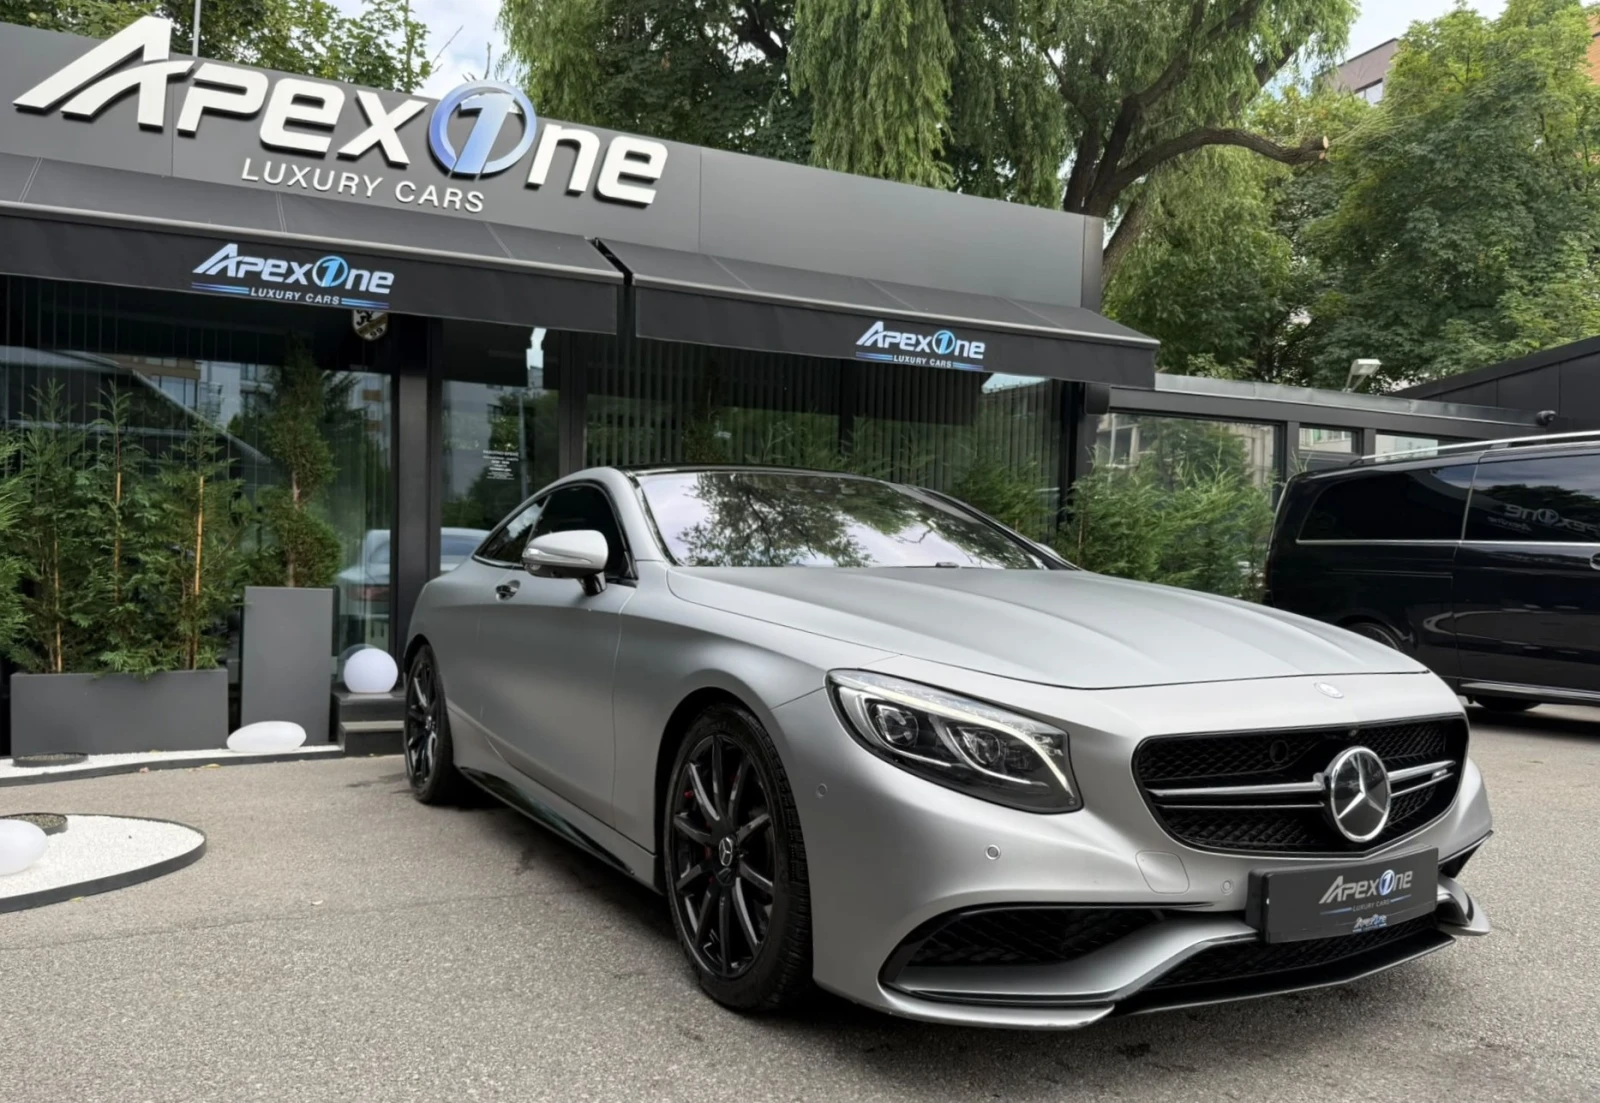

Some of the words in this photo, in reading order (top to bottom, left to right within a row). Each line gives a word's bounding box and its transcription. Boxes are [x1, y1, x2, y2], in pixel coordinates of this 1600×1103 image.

[241, 157, 383, 198] LUXURY
[394, 180, 485, 214] CARS
[250, 287, 302, 301] LUXURY
[305, 293, 340, 305] CARS
[893, 355, 927, 364] LUXURY
[929, 359, 952, 368] CARS
[1353, 903, 1375, 912] LUXURY
[1376, 899, 1390, 907] CARS
